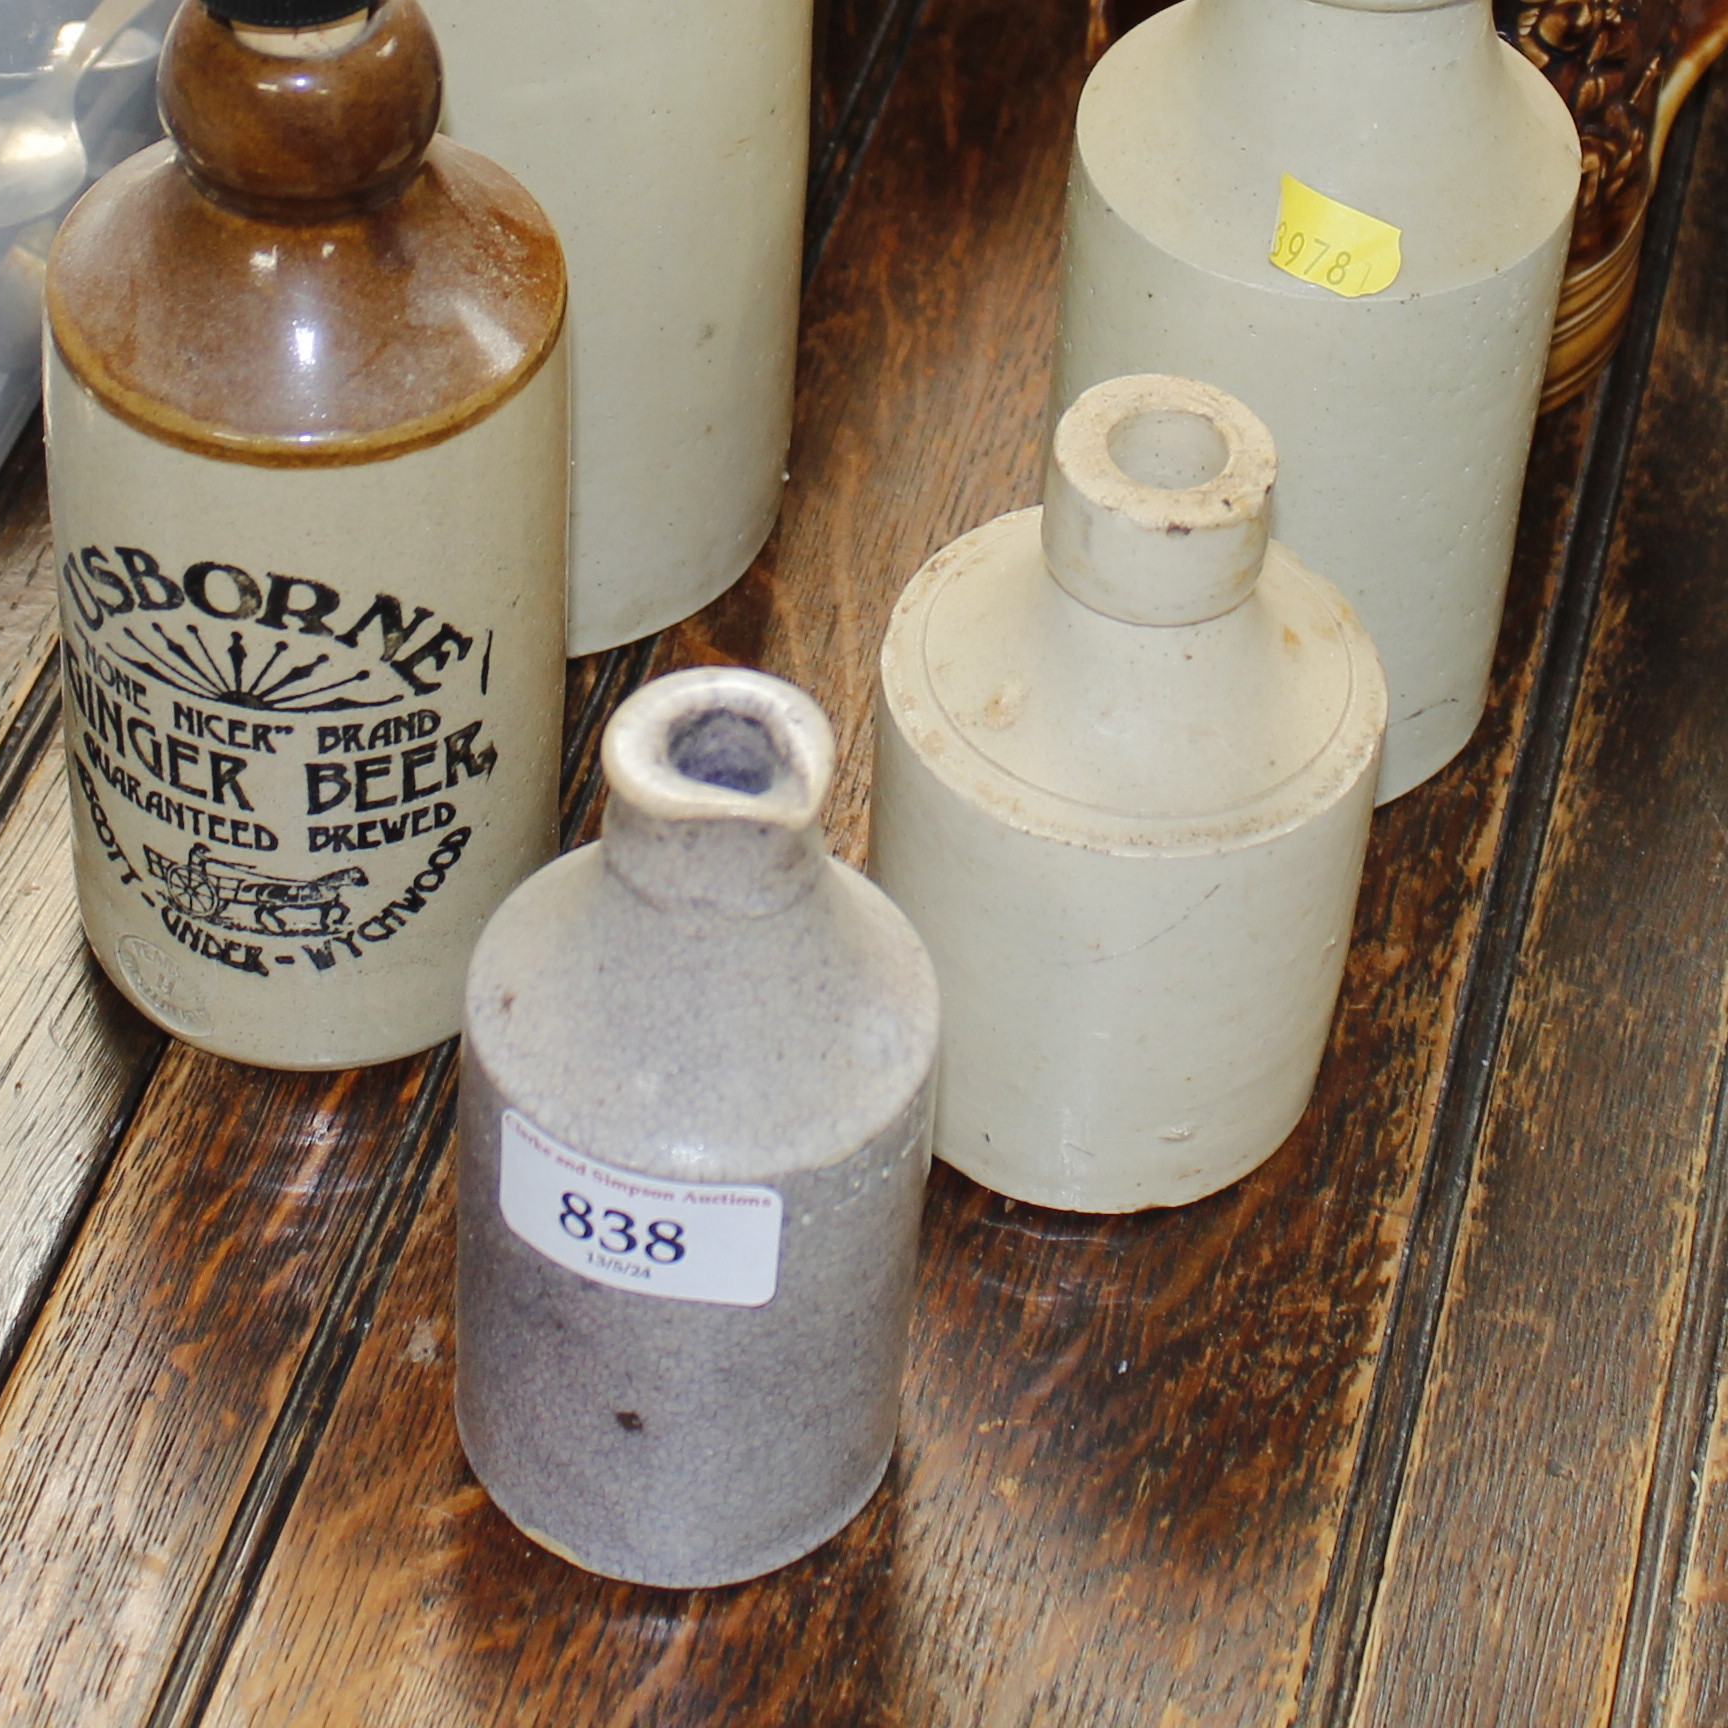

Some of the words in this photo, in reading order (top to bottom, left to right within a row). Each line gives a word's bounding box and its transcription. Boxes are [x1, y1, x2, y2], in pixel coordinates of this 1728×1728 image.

[65, 639, 256, 812] GINGER
[317, 709, 440, 755] BRAND
[83, 731, 279, 853] GUARANTEED
[307, 802, 457, 854] BREWED
[161, 905, 269, 977] UNDER
[301, 826, 473, 972] WYCHWOOD
[503, 1112, 552, 1157] Clarke
[555, 1154, 587, 1177] and
[591, 1170, 676, 1202] Simpson
[682, 1190, 773, 1209] Auctions
[559, 1191, 686, 1265] 838
[585, 1251, 652, 1280] 13/5/24
